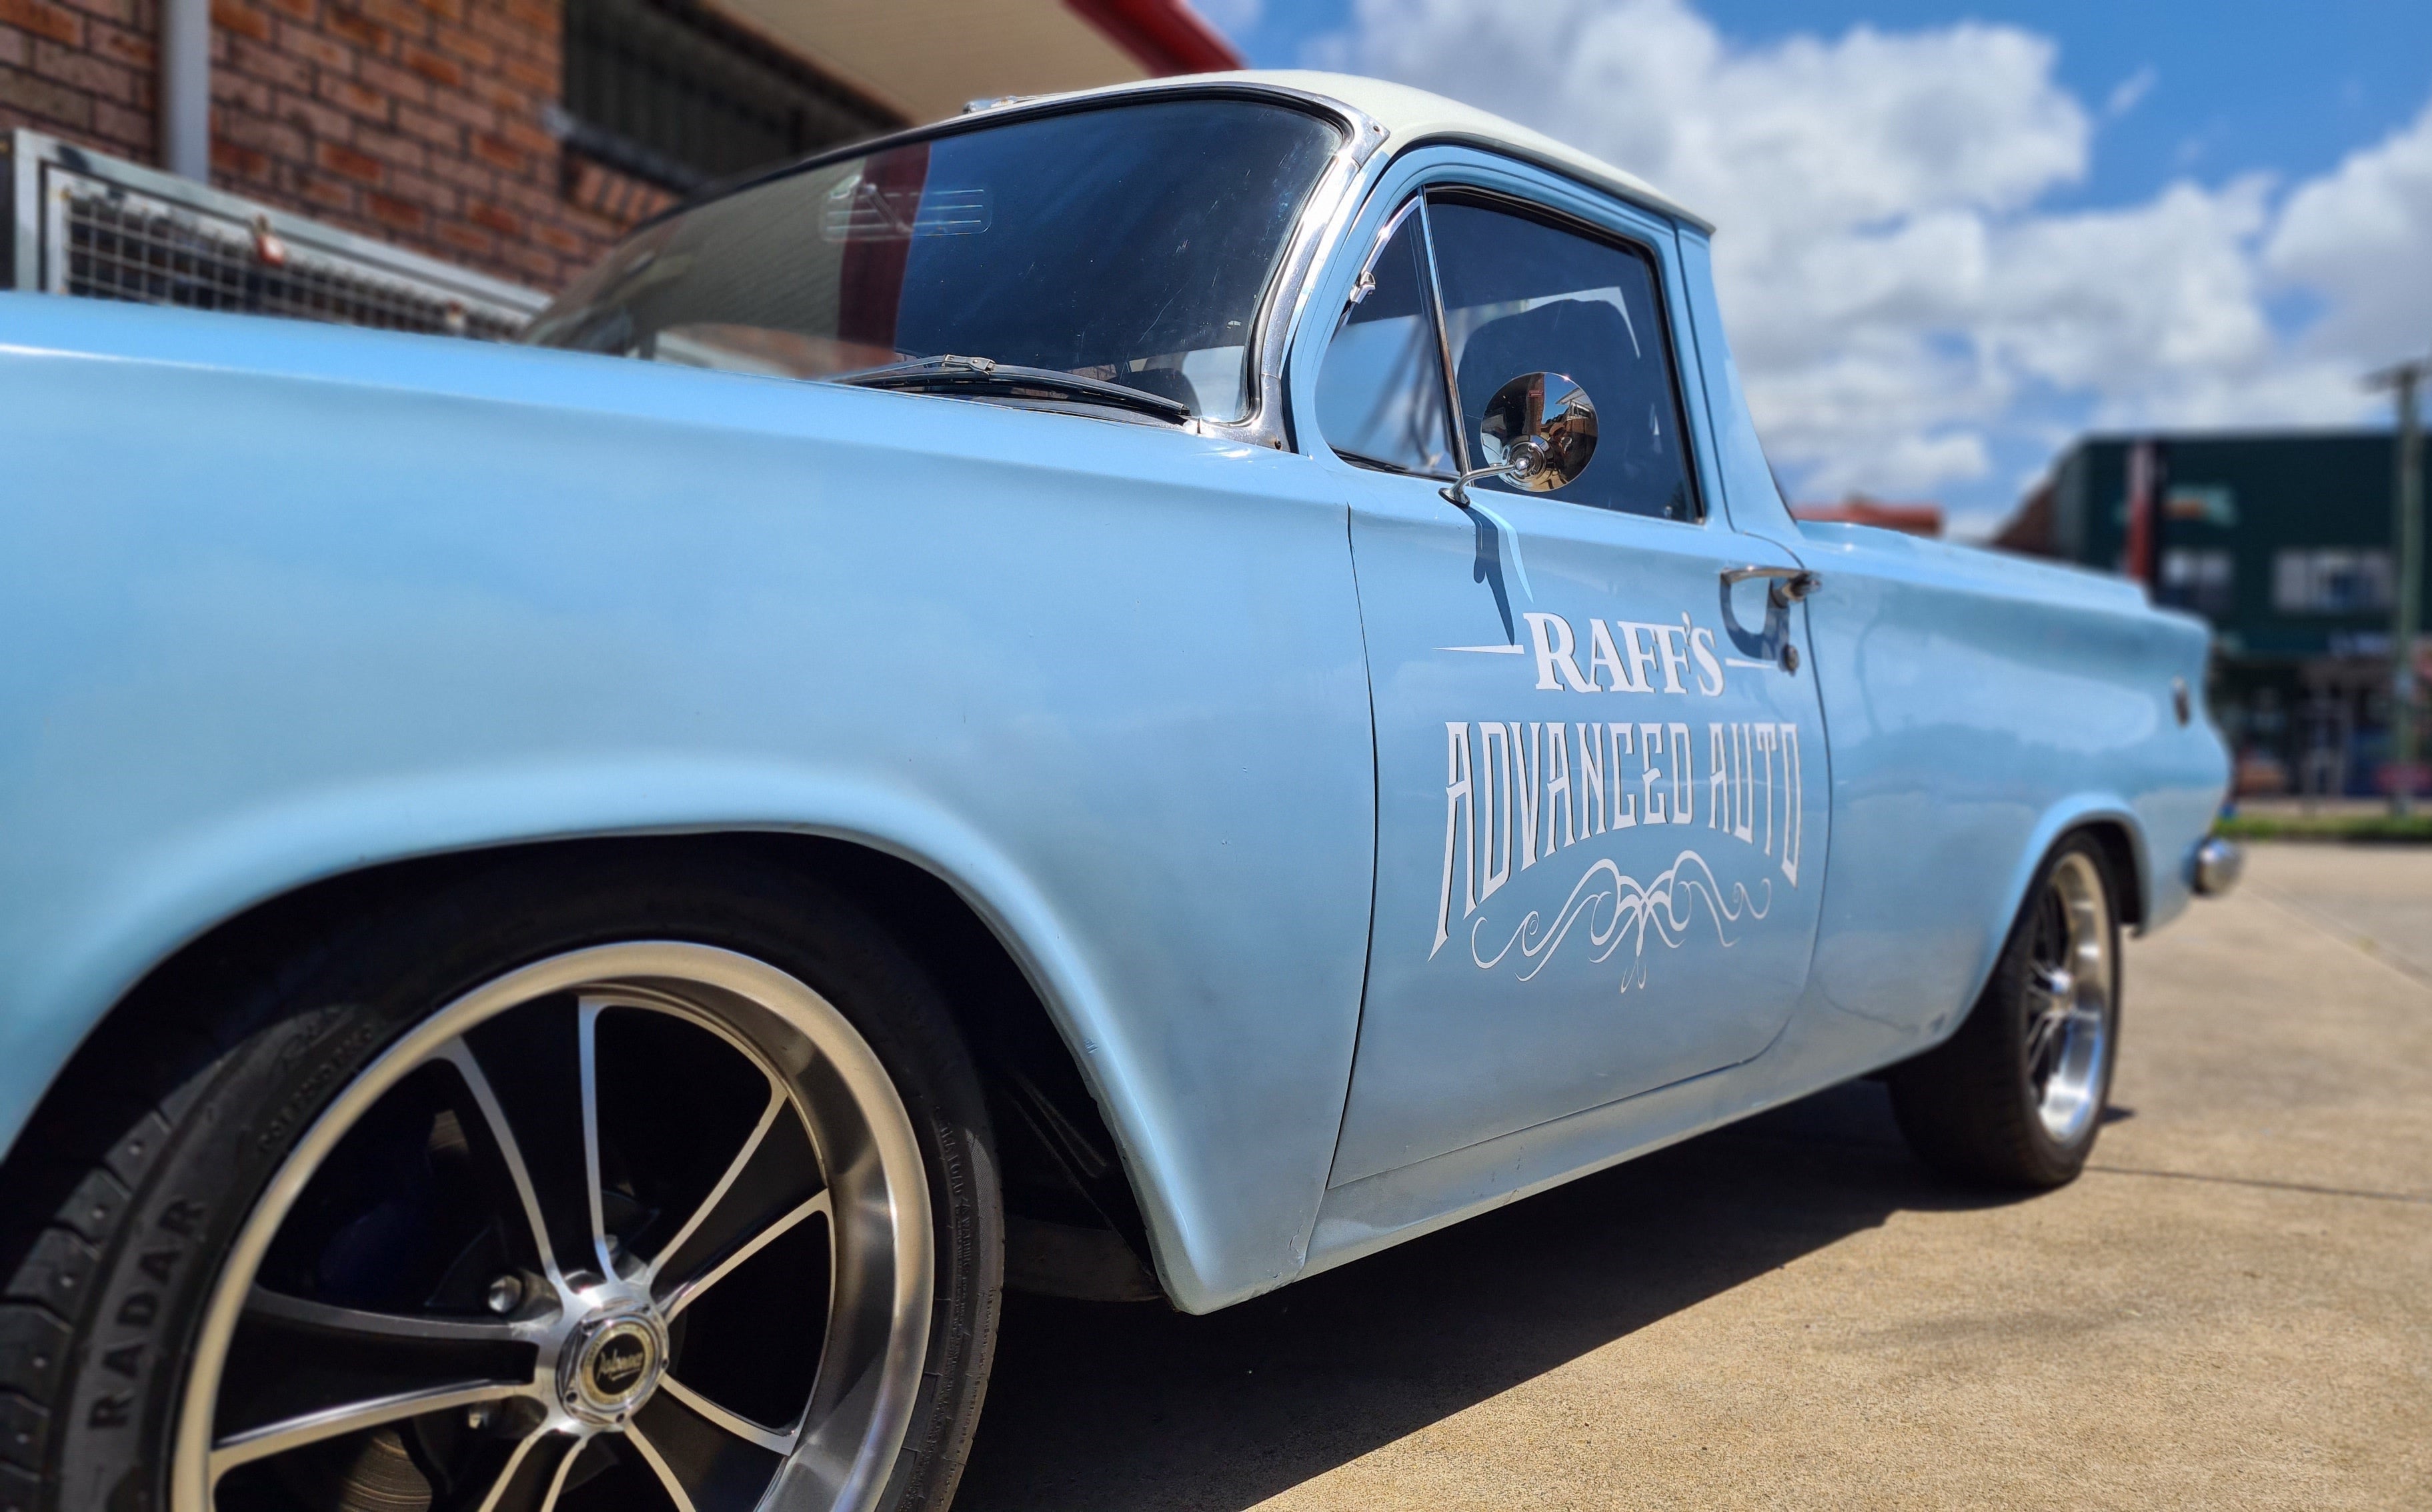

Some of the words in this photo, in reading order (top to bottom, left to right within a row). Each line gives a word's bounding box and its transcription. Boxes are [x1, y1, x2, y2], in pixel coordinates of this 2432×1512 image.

[1523, 611, 1725, 697] RAFF'S
[1428, 721, 1694, 962] ADVANCED
[1708, 722, 1802, 890] AUTO
[88, 1199, 205, 1430] RADAR
